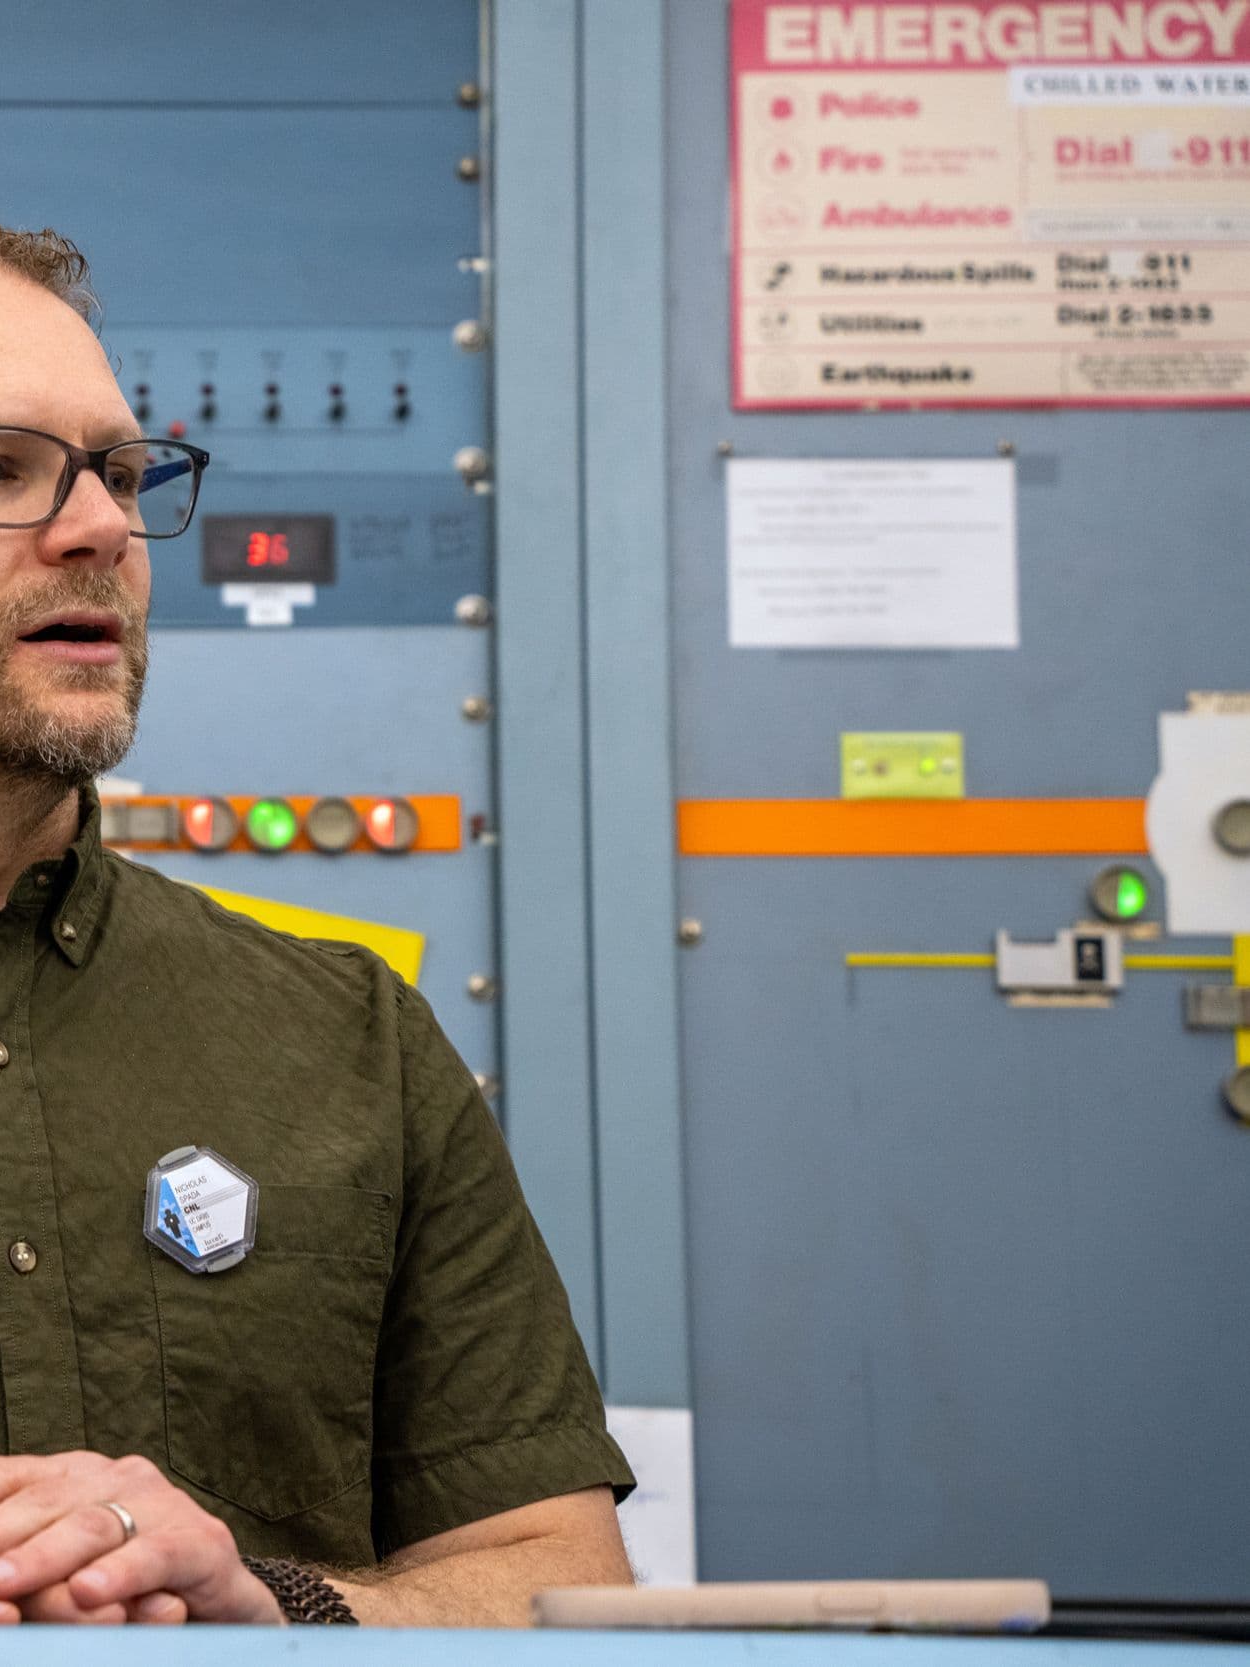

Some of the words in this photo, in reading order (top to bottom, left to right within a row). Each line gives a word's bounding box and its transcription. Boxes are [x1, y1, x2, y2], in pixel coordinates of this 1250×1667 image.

[764, 0, 1247, 63] EMERGENCY
[1023, 73, 1141, 96] CHILLED
[1154, 72, 1250, 96] WATER
[818, 91, 920, 119] Police
[818, 146, 884, 173] Fire
[1054, 137, 1133, 166] Dial
[822, 201, 1013, 230] Ambulance
[1057, 253, 1109, 272] Dial
[819, 312, 924, 334] Utilities
[1057, 304, 1109, 325] Dial
[820, 362, 975, 389] Earthquake
[175, 1175, 208, 1193] NICHOLAS
[184, 1203, 201, 1215] CNL
